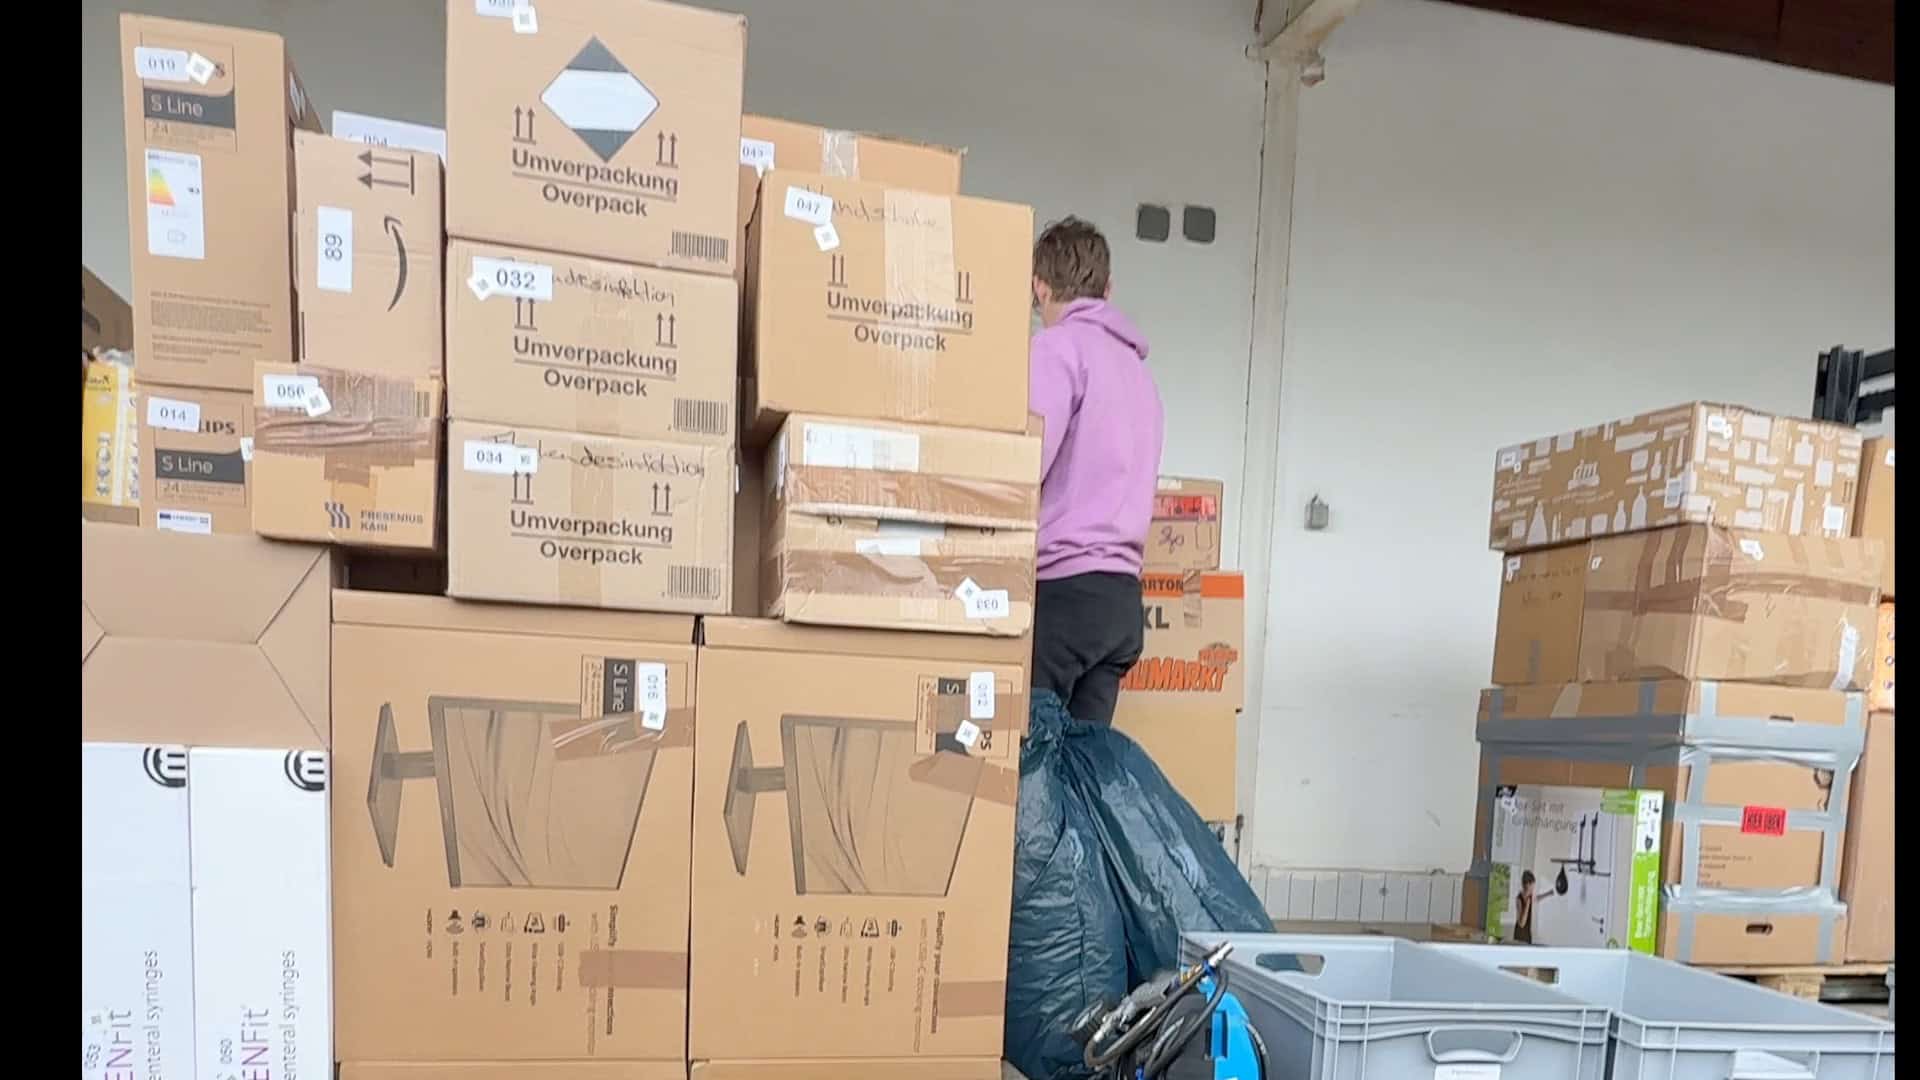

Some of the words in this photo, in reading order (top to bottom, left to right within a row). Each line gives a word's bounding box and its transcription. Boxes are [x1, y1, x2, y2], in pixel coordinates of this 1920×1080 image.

[151, 95, 162, 112] S
[167, 96, 203, 117] Line
[511, 148, 679, 196] Umverpackung
[542, 183, 648, 217] Overpack
[496, 268, 536, 290] 032
[826, 290, 973, 329] Umverpackung
[854, 323, 946, 351] Overpack
[513, 335, 678, 375] Umverpackung
[543, 369, 648, 397] Overpack
[162, 457, 173, 472] S
[178, 458, 213, 475] Line
[510, 510, 673, 543] Umverpackung
[540, 539, 643, 566] Overpack
[1141, 579, 1184, 592] ARTON
[614, 664, 628, 675] S
[612, 678, 628, 712] Line
[143, 950, 163, 1021] syringes
[279, 950, 300, 1021] syringes
